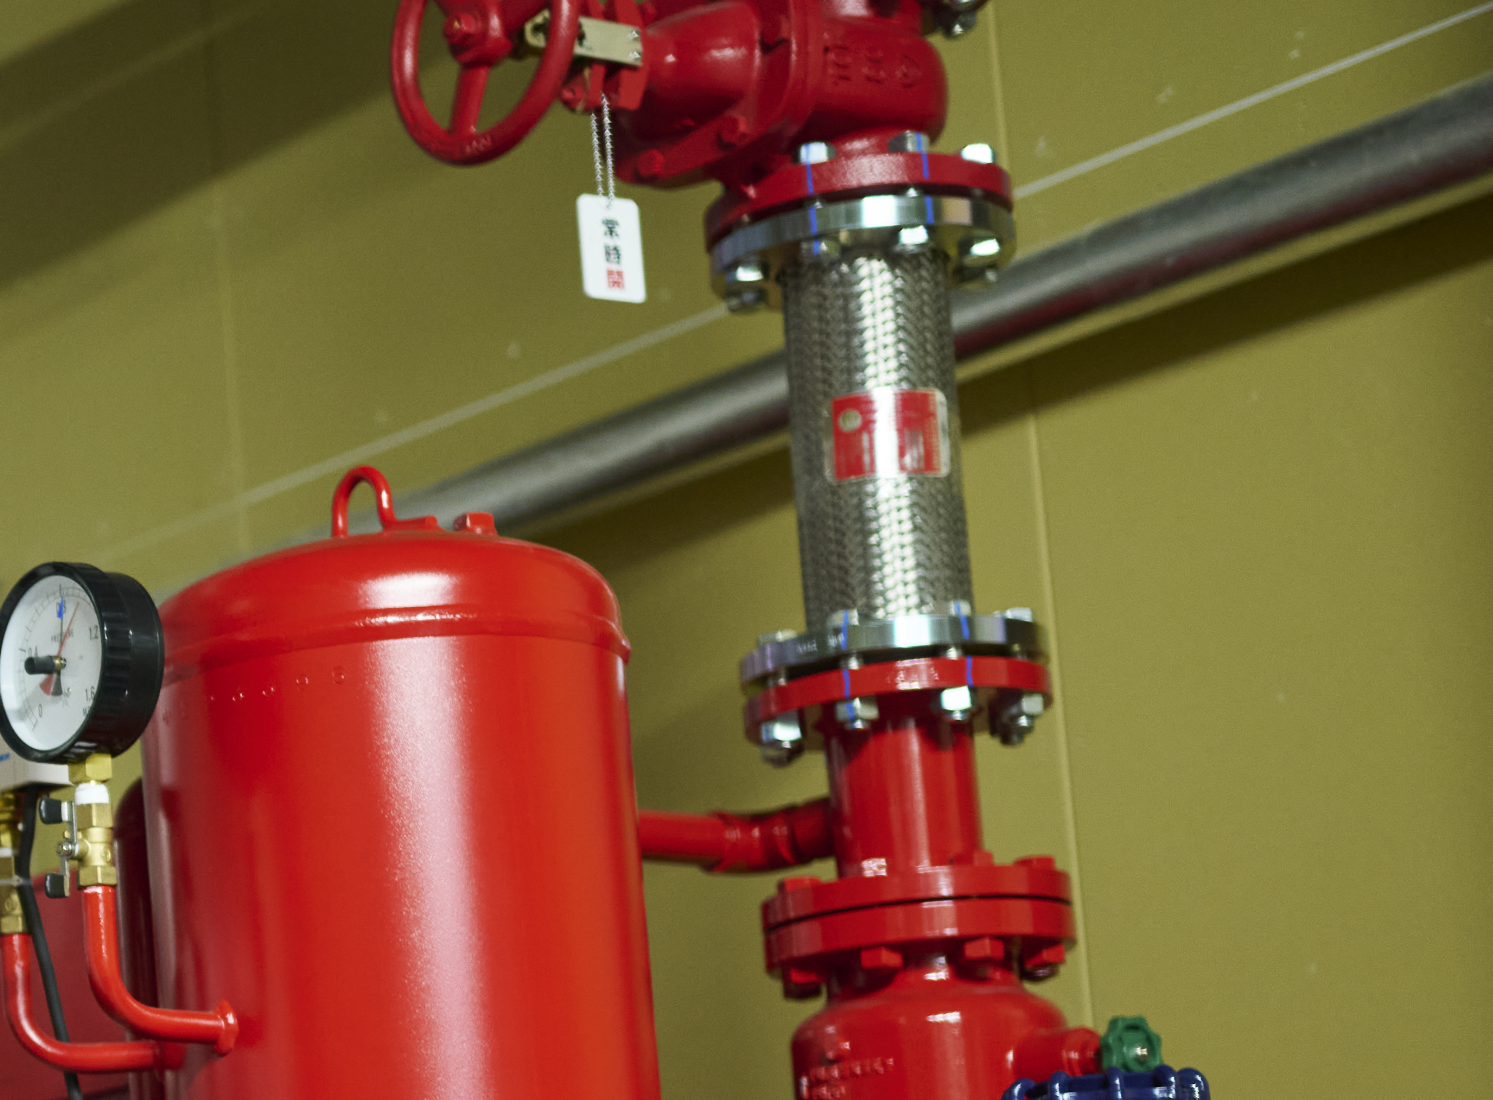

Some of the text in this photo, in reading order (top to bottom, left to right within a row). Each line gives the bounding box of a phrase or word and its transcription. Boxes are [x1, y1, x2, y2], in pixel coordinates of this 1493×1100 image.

[89, 625, 99, 640] 1.2
[85, 686, 95, 702] 1.6
[38, 703, 43, 718] 0
